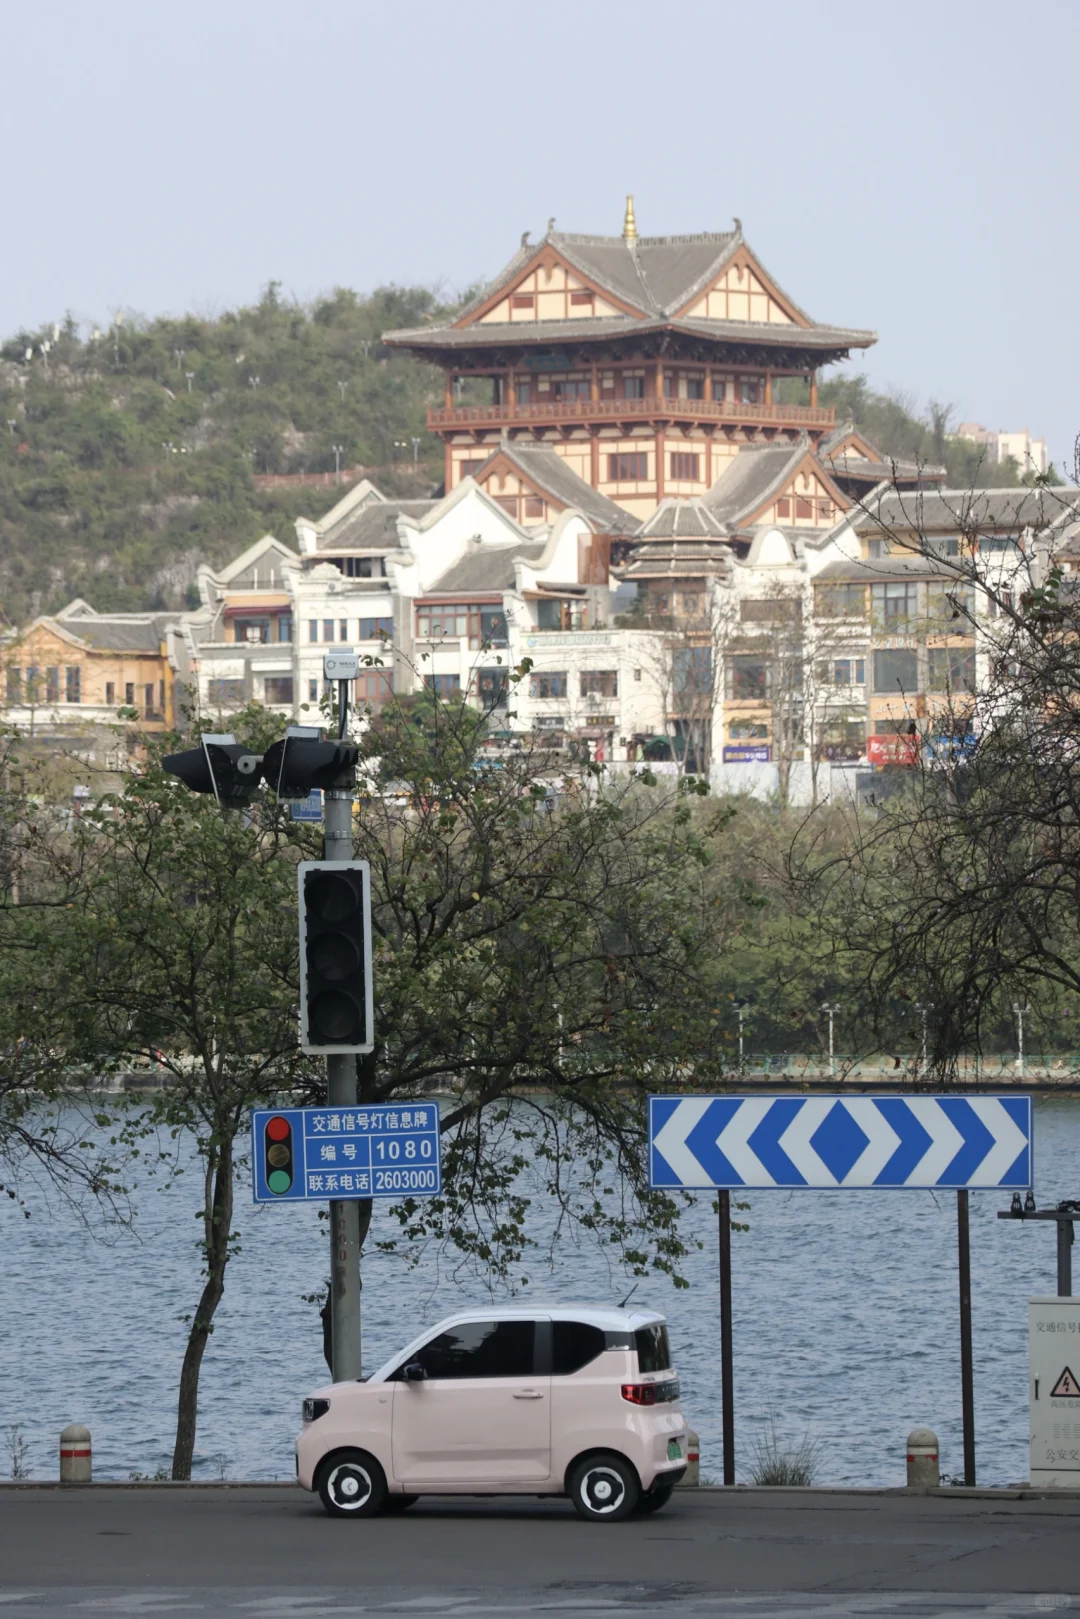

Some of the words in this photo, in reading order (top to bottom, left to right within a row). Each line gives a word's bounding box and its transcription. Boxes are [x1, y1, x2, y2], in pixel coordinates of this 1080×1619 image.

[312, 1111, 429, 1132] 交通信号灯信息牌
[320, 1143, 358, 1162] 编号
[376, 1139, 432, 1160] 1080
[308, 1173, 370, 1192] 联系电话
[375, 1169, 435, 1190] 2603000
